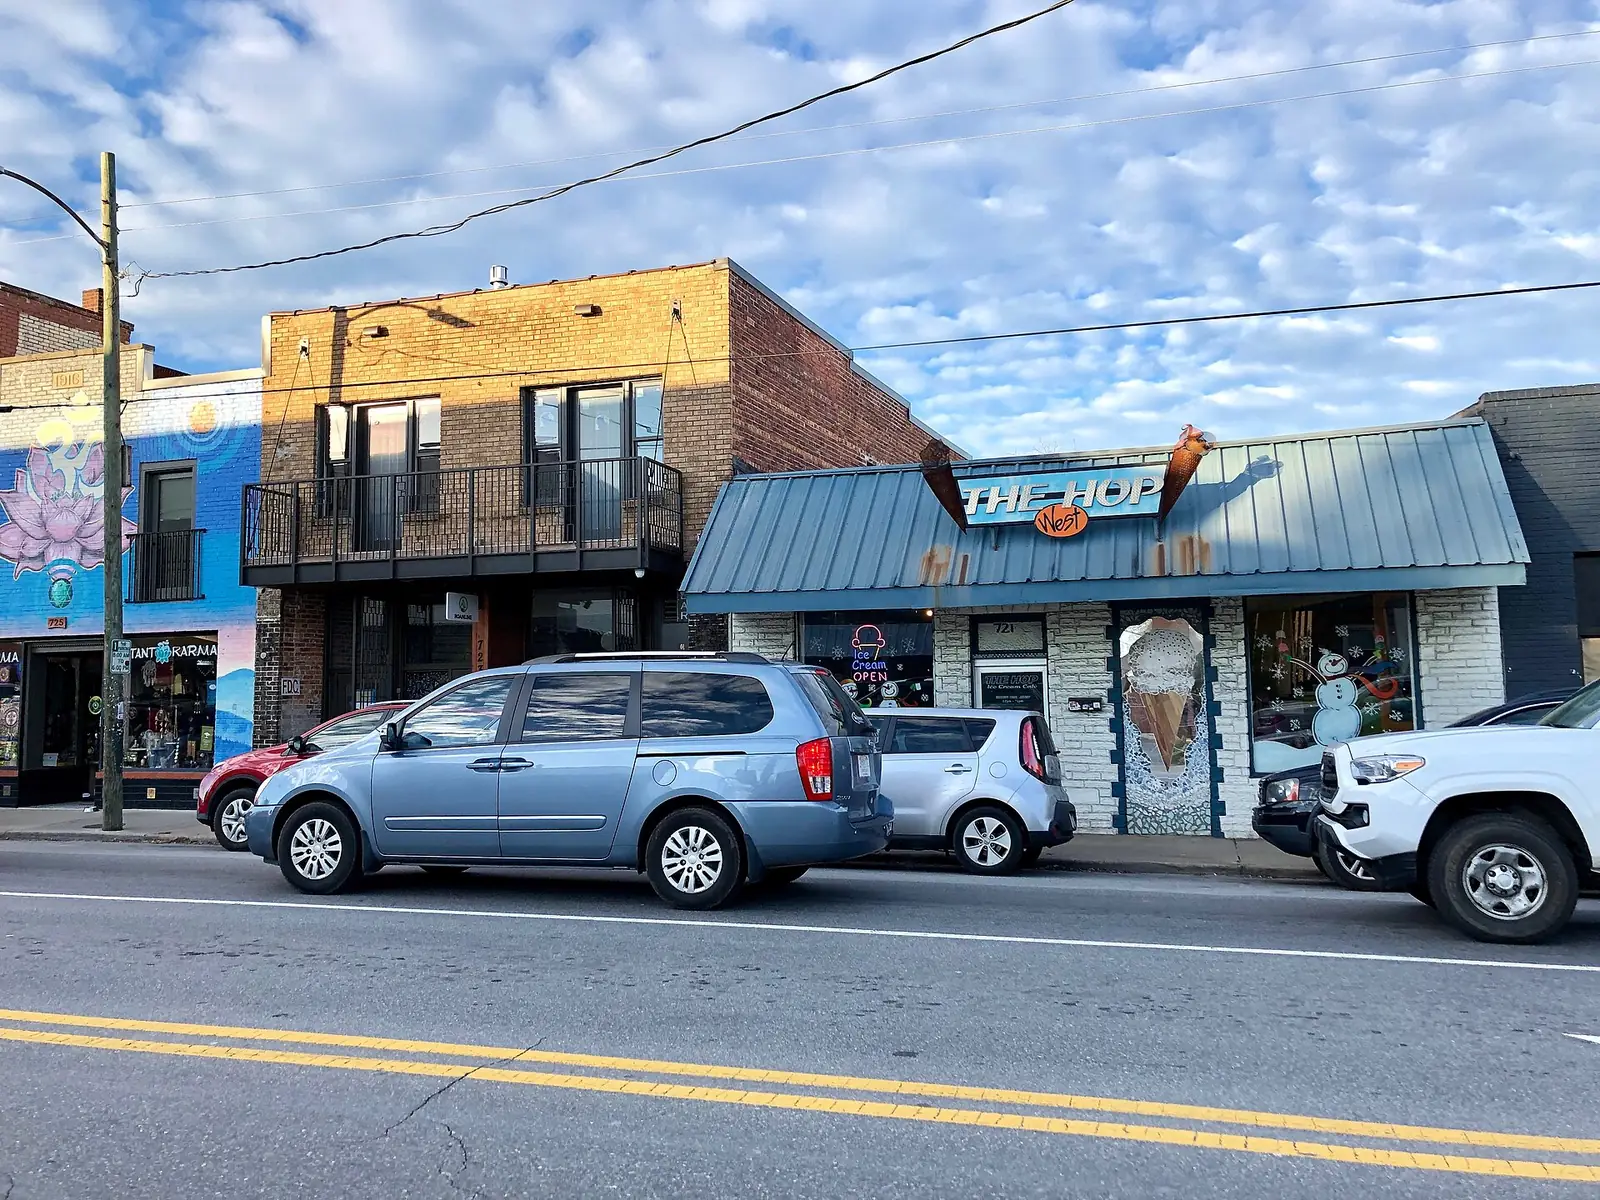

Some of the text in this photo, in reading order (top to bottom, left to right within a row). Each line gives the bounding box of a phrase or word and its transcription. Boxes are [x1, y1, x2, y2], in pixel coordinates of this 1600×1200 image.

[963, 476, 1165, 515] THE HOP
[1038, 506, 1081, 533] West
[49, 618, 64, 627] 725
[994, 623, 1015, 633] 721
[854, 649, 870, 659] Ice
[852, 660, 886, 670] Cream
[853, 672, 888, 681] OPEN
